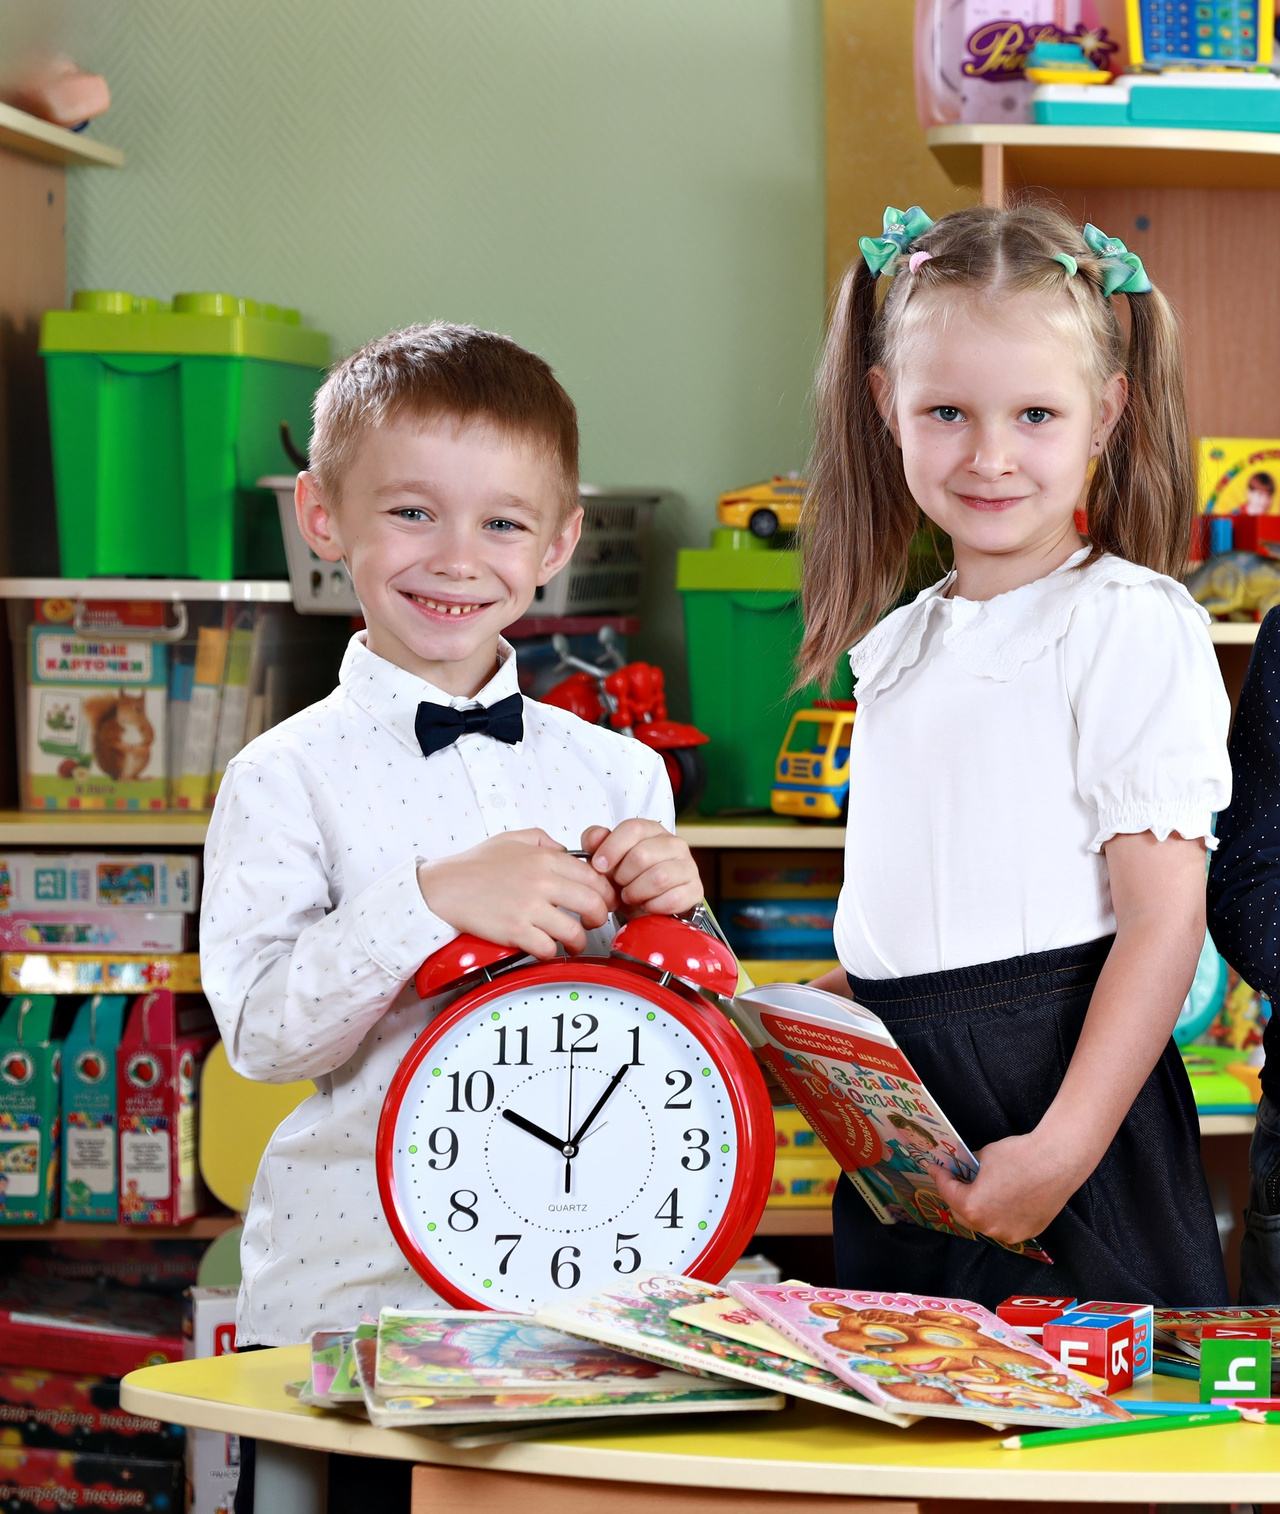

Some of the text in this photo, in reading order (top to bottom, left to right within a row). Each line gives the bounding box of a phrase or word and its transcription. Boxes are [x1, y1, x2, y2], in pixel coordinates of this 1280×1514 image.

[46, 659, 143, 673] КАРТОЧКИ
[492, 1025, 534, 1066] 11
[550, 1013, 600, 1053] 12
[627, 1026, 645, 1066] 1
[774, 1019, 855, 1050] Библиотека
[784, 1033, 899, 1071] начальной школы
[445, 1070, 496, 1113] 10
[663, 1069, 693, 1110] 2
[801, 1075, 846, 1101] 100
[427, 1126, 460, 1171] 9
[680, 1128, 712, 1171] 3
[447, 1189, 479, 1232] 8
[547, 1203, 588, 1213] QUARTZ
[653, 1187, 685, 1229] 4
[494, 1234, 523, 1276] 7
[550, 1245, 582, 1290] 6
[612, 1232, 643, 1274] 5
[754, 1289, 987, 1318] ТЕРЕМОК
[1111, 1337, 1129, 1376] Я
[1134, 1323, 1147, 1367] ВО
